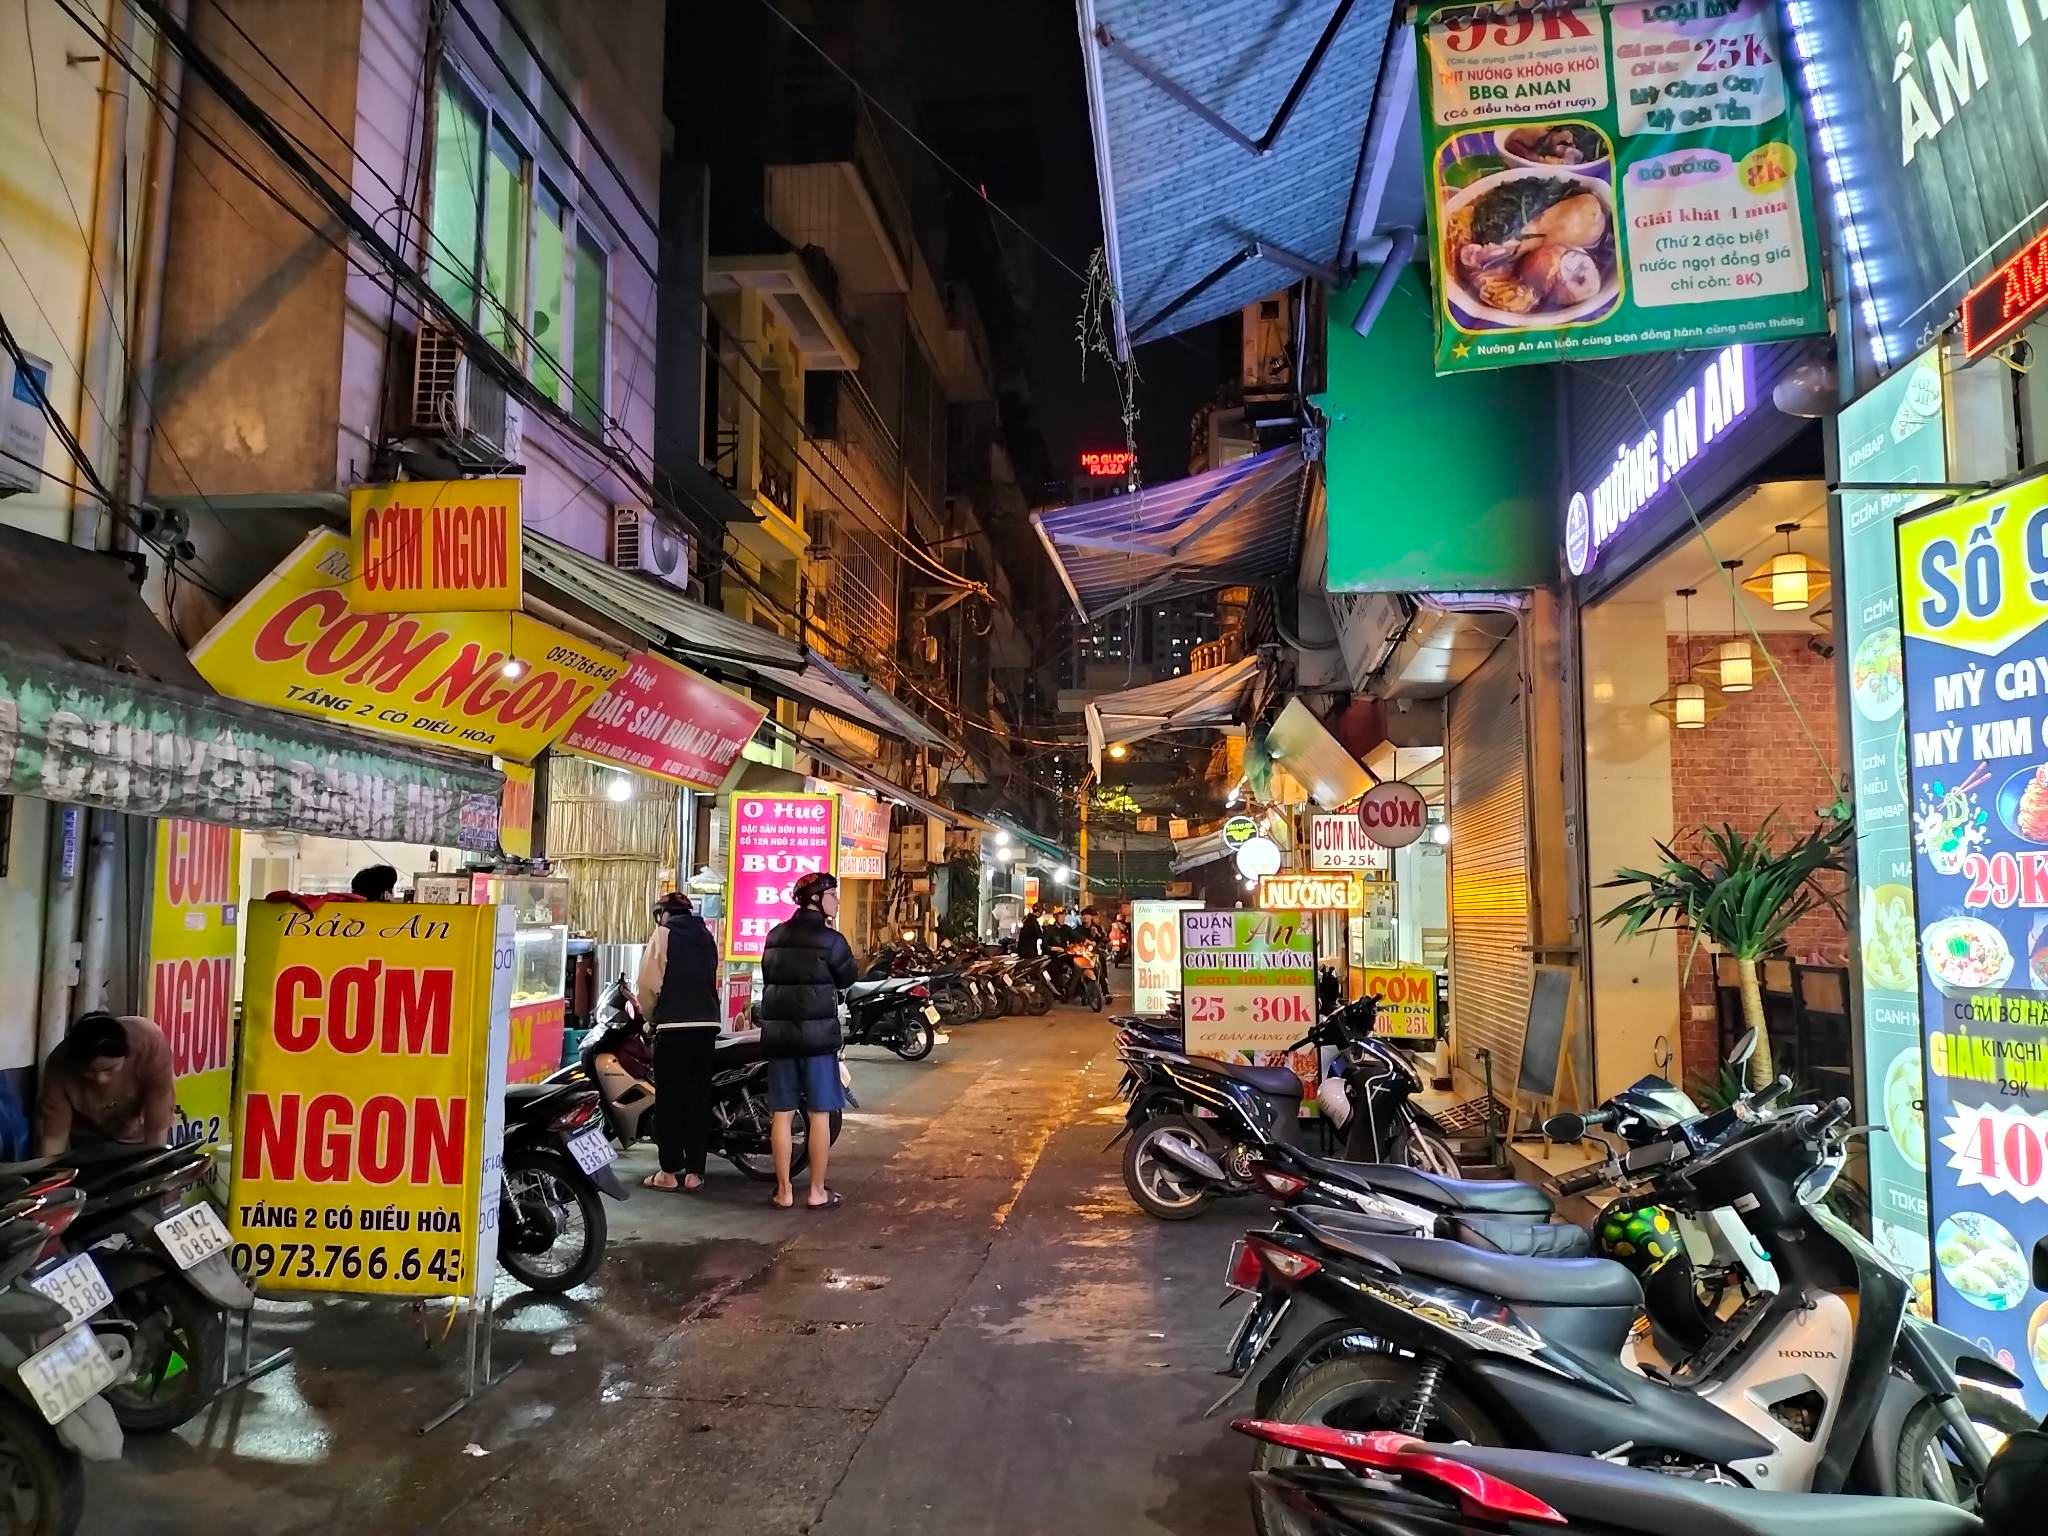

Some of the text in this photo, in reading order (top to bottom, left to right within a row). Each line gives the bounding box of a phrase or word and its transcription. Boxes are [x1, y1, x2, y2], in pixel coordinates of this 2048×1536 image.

[1467, 64, 1513, 81] NƯỚNG
[1517, 60, 1564, 78] KHÔNG
[1469, 78, 1571, 101] BBQ ANAN
[1892, 3, 1989, 167] ẨM
[1506, 98, 1530, 112] hòa
[1535, 97, 1561, 111] mát
[1679, 206, 1720, 222] khát
[1655, 229, 1770, 252] (Thứ 2 đặc biệt
[1639, 245, 1791, 273] nước ngọt đồng giá
[1698, 274, 1731, 290] còn:
[1735, 273, 1763, 287] 8K)
[1477, 342, 1515, 356] Nướng
[1518, 341, 1535, 351] An
[1536, 339, 1553, 350] An
[1554, 336, 1580, 348] luôn
[1582, 334, 1612, 347] cùng
[1615, 332, 1638, 345] bạn
[1640, 329, 1671, 342] đồng
[1673, 325, 1703, 338] hành
[1738, 319, 1767, 332] năm
[1769, 315, 1804, 328] tháng
[1592, 430, 1659, 547] NƯỚNG
[1663, 386, 1698, 484] AN
[1704, 344, 1745, 444] AN
[1848, 434, 1884, 469] KIMBAP
[1090, 464, 1126, 475] PLAZA
[1851, 500, 1879, 528] CƠM
[364, 502, 508, 592] CƠM NGON
[1921, 505, 2007, 628] SỐ
[1863, 597, 1894, 623] CƠM
[545, 646, 618, 682] 0973.766.643
[414, 643, 594, 733] NGON
[630, 664, 658, 695] Huệ
[1934, 662, 1985, 713] MỲ
[285, 685, 497, 745] TẦNG 2 CÓ ĐIỀU HÒA
[586, 688, 634, 730] ĐẶC
[627, 701, 670, 746] SẢN
[662, 717, 702, 752] BÚN
[712, 736, 747, 767] HUẾ
[622, 749, 632, 761] 2
[1914, 719, 1963, 768] MỲ
[1972, 716, 2033, 762] KIM
[743, 801, 826, 822] O Huệ
[1362, 795, 1421, 828] CƠM
[739, 834, 752, 846] SỐ
[753, 837, 769, 846] 12A
[789, 838, 796, 846] 2
[809, 838, 828, 847] SEN
[759, 823, 777, 834] SẢN
[778, 823, 796, 834] BÚN
[809, 823, 827, 835] HUẾ
[1314, 818, 1385, 851] CƠM NG
[741, 850, 823, 873] BÚN
[868, 857, 881, 874] SEN
[1323, 855, 1376, 867] 20-25k
[1266, 878, 1347, 907] NƯỚNG
[1963, 851, 2048, 908] 29K
[378, 913, 454, 939] An
[1186, 913, 1294, 945] QUÁN An
[1185, 949, 1312, 973] CƠM THỊT NƯỚNG
[1236, 973, 1306, 985] sinh viên
[1369, 972, 1429, 1004] CƠM
[272, 959, 455, 1056] CƠM
[1191, 995, 1312, 1022] 25 30k
[1875, 1008, 1910, 1025] CANH
[1954, 1003, 1993, 1022] CƠM
[2000, 1001, 2021, 1024] BÒ
[1406, 1016, 1429, 1035] 25k
[1982, 1039, 2041, 1062] KIMCHI
[1998, 1078, 2030, 1098] 29K
[208, 1117, 221, 1143] 2
[241, 1093, 466, 1187] NGON
[1963, 1117, 2048, 1187] 40
[239, 1200, 297, 1228] TẦNG
[304, 1208, 317, 1229] 2
[324, 1203, 352, 1230] CÓ
[360, 1201, 410, 1232] ĐIỀU
[417, 1204, 461, 1233] HÒA
[231, 1242, 465, 1283] 0973.766.643
[1777, 1350, 1838, 1359] HONDA
